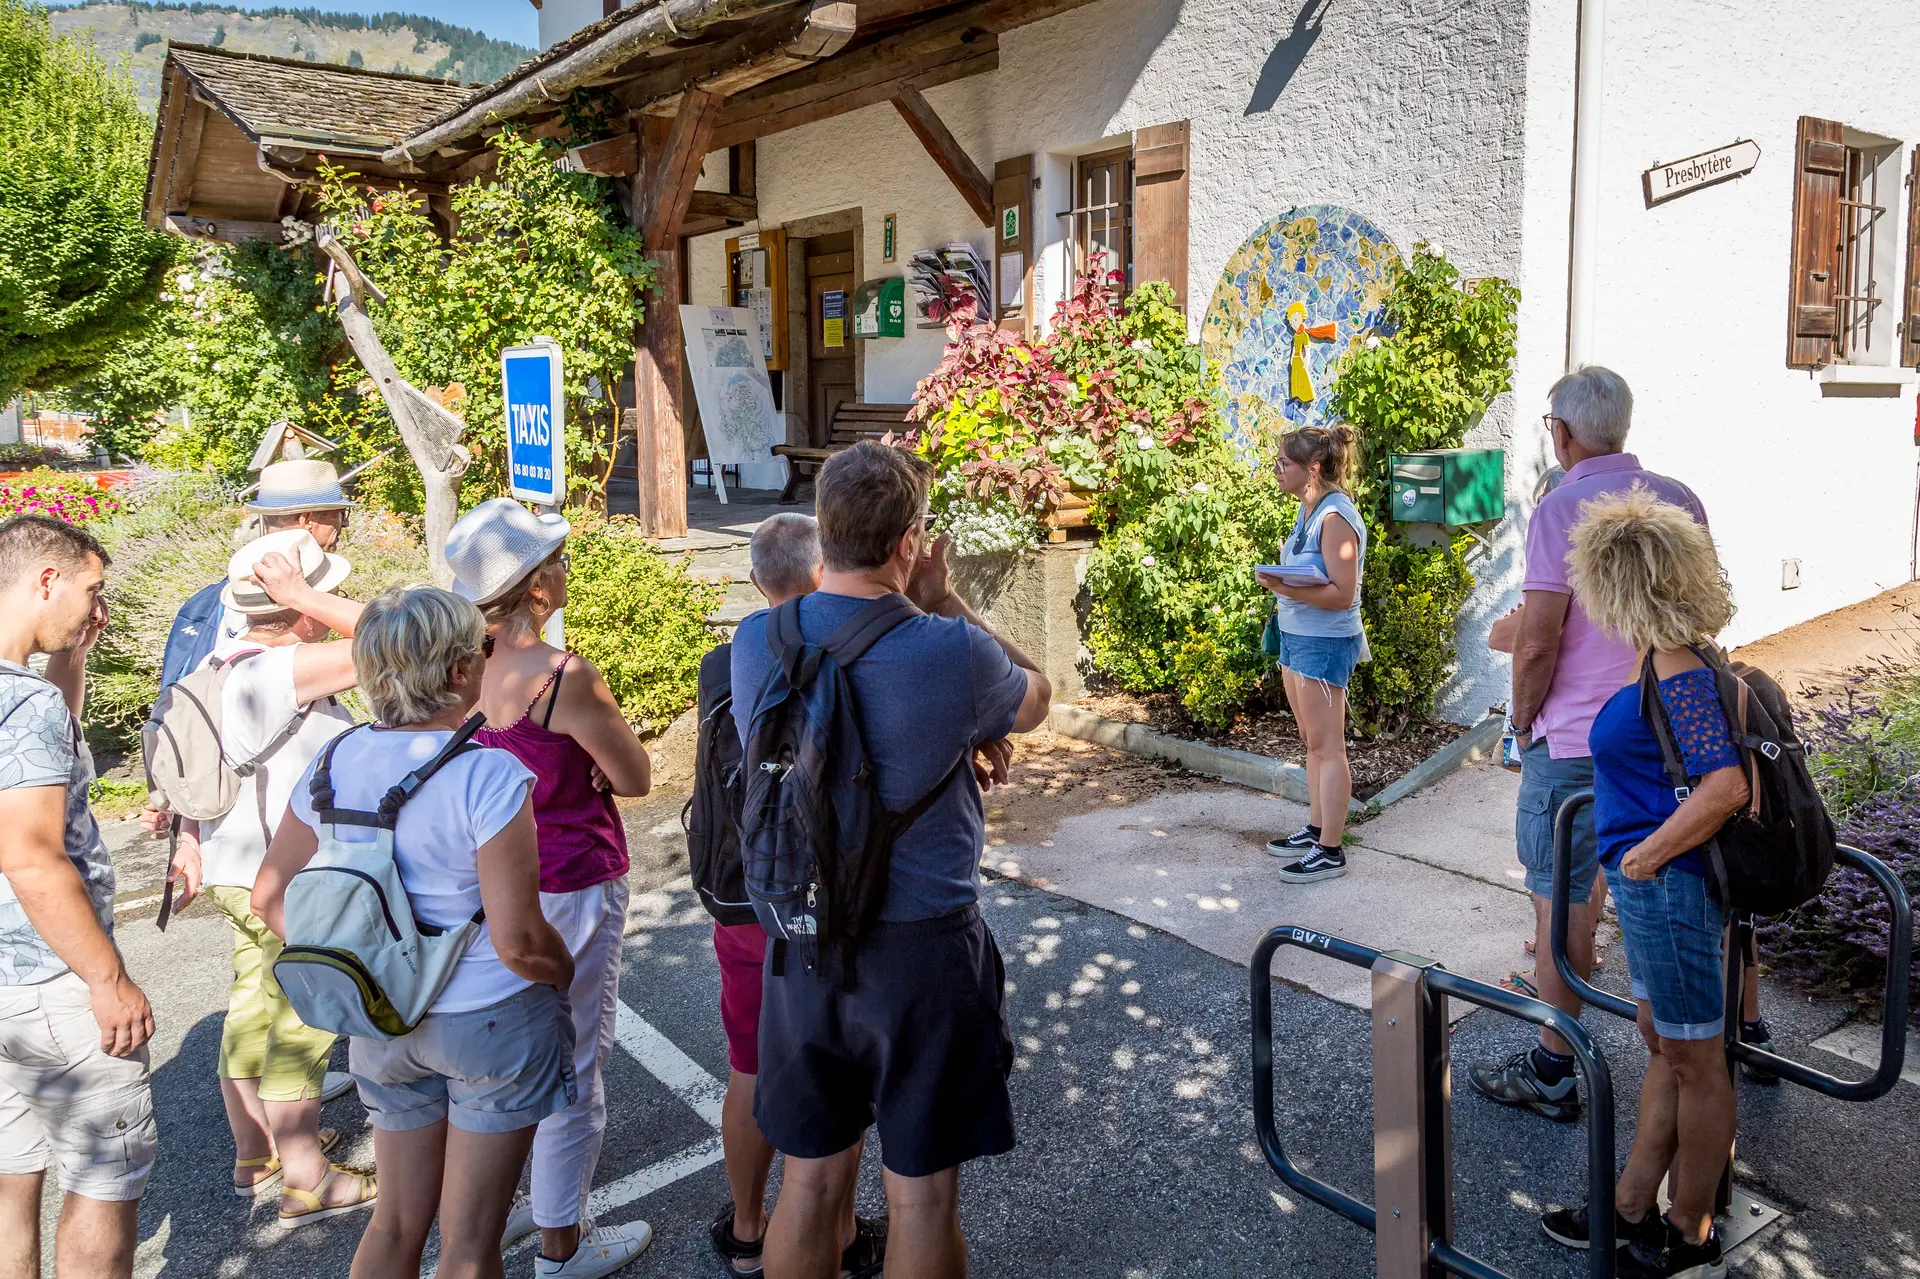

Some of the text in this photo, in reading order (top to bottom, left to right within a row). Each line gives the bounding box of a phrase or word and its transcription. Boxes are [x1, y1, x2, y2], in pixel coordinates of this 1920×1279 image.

[1665, 154, 1732, 188] Presbytère
[511, 403, 550, 447] TAXIS
[514, 463, 521, 475] 06
[522, 464, 528, 477] 80
[530, 465, 536, 478] 03
[544, 468, 551, 480] 20
